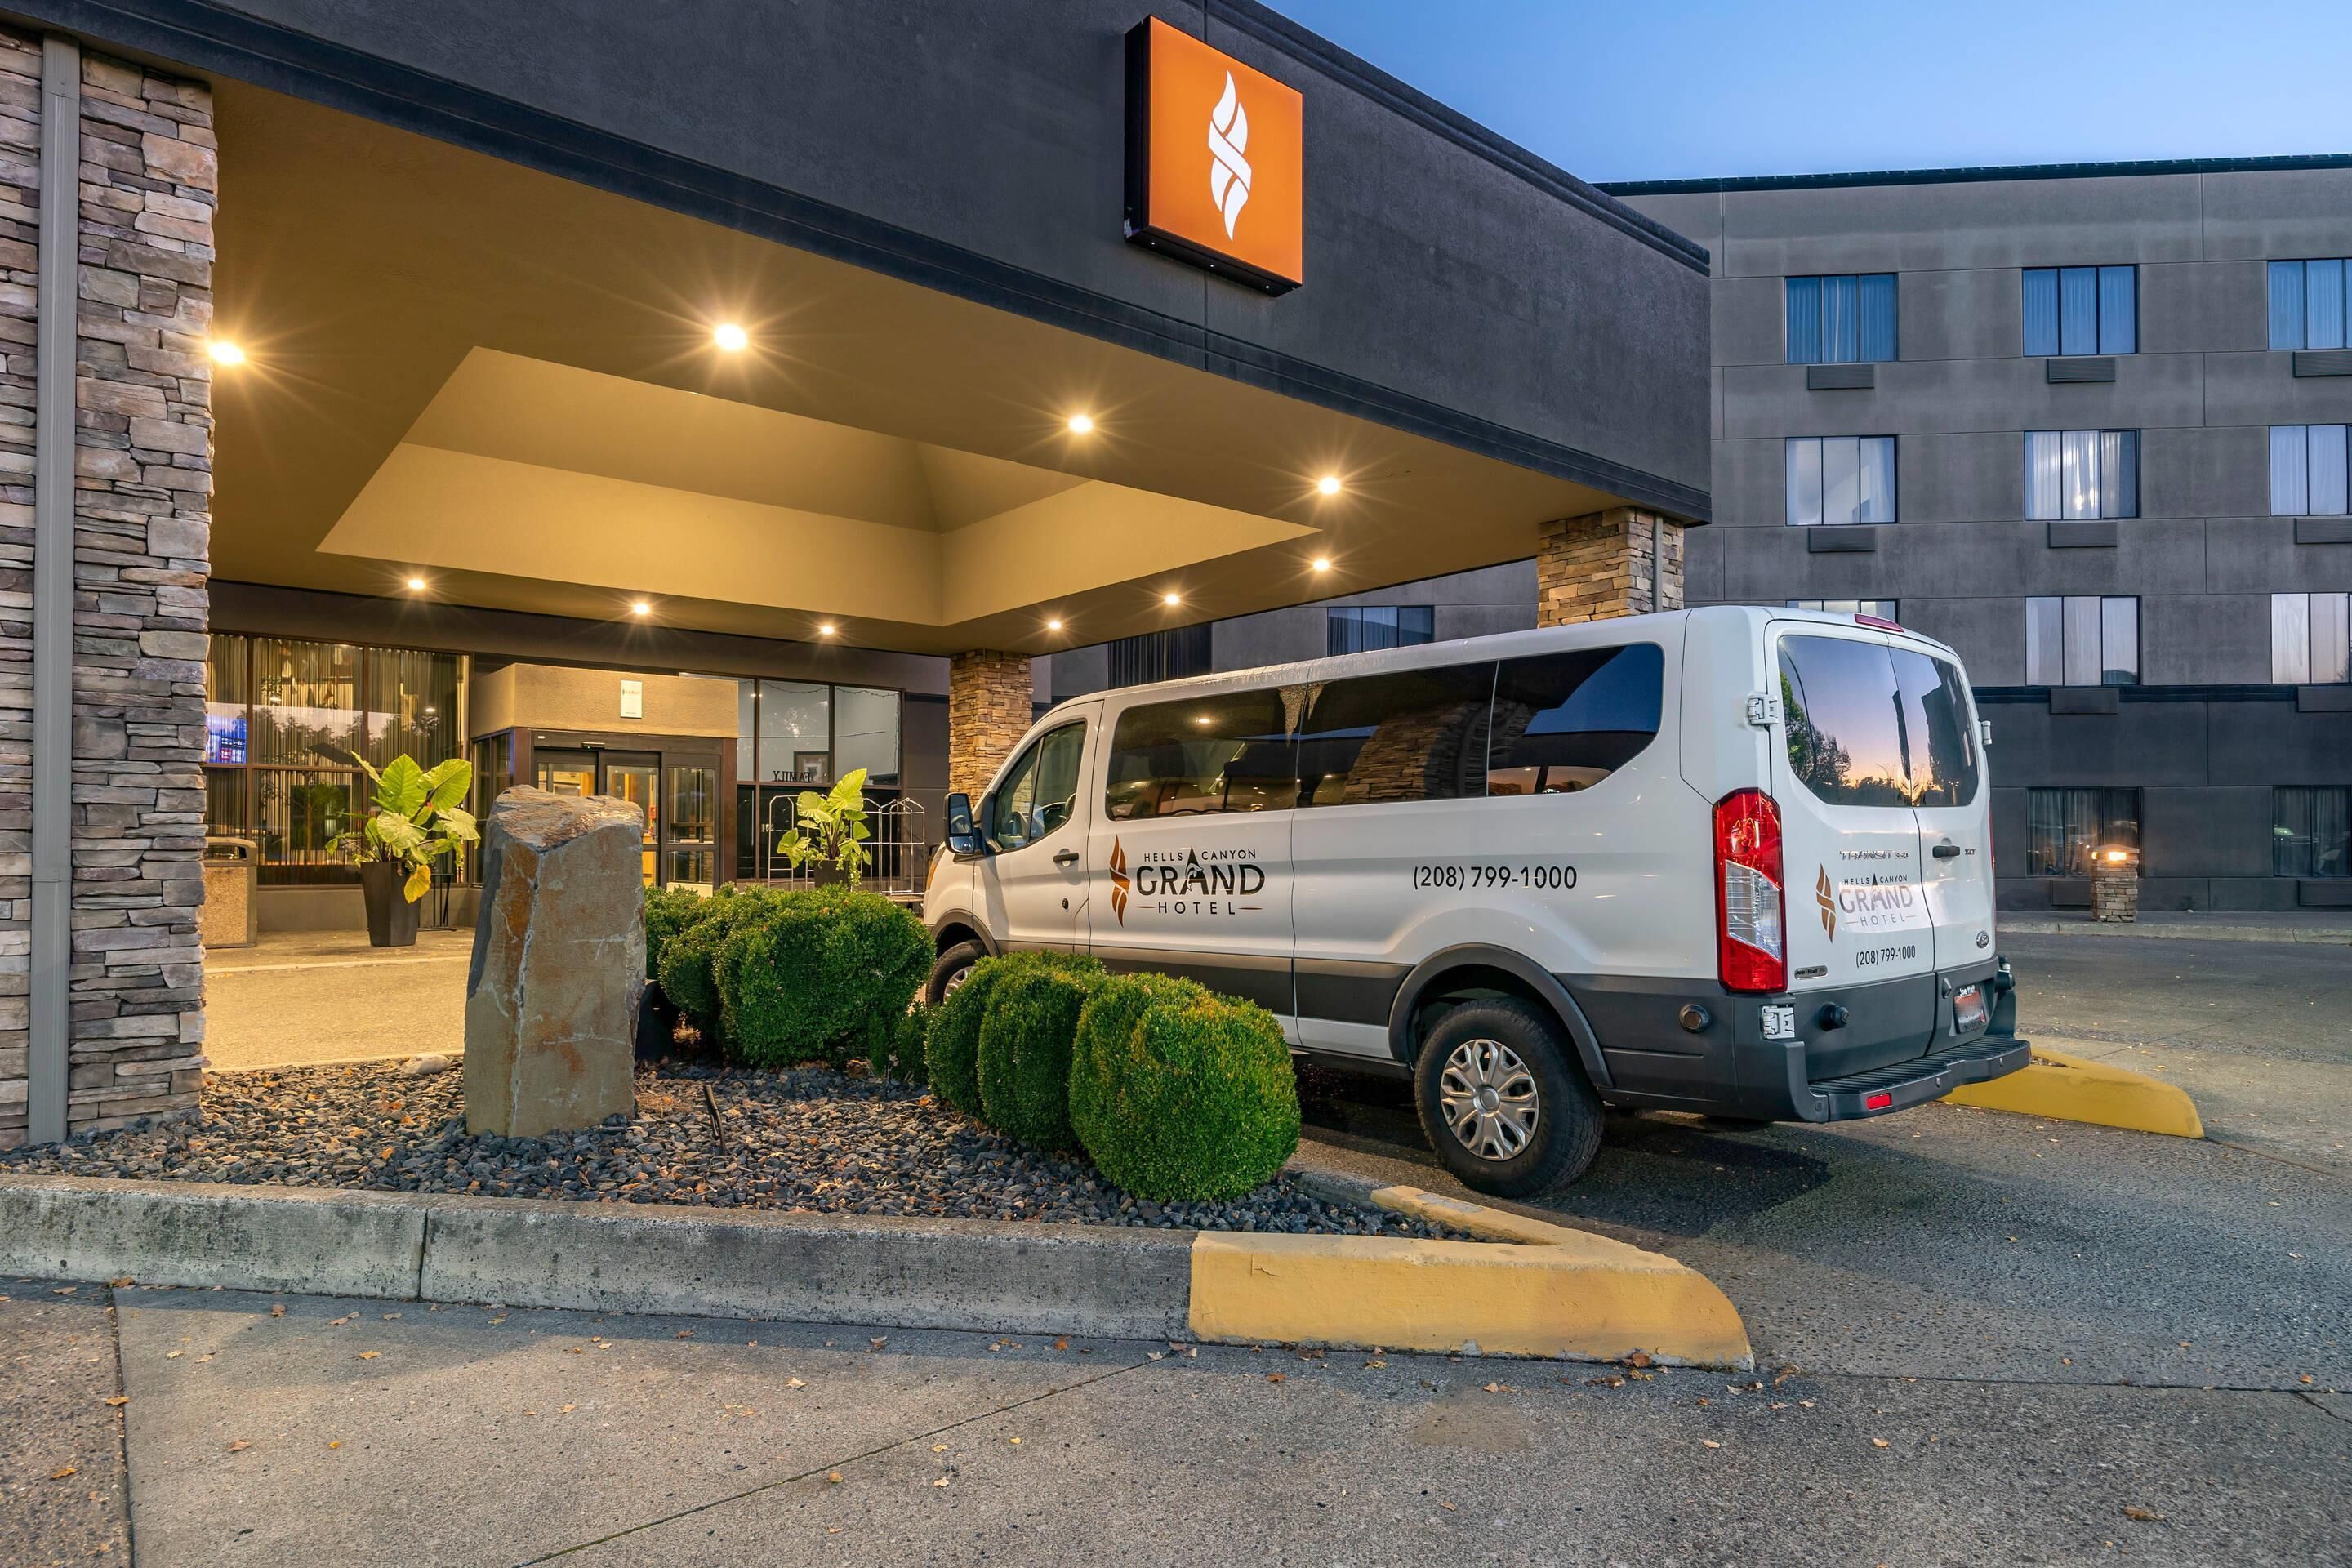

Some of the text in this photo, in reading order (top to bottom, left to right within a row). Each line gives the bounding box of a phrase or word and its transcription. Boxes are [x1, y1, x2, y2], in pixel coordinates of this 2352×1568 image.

[1144, 849, 1256, 862] HELLS CANYON
[1840, 850, 1892, 860] TRANSIT
[1136, 846, 1265, 896] GRAND
[1414, 866, 1577, 891] (208) 799-1000
[1844, 875, 1908, 885] HELLS CANYON
[1839, 873, 1913, 914] GRAND
[1158, 901, 1236, 915] HOTEL
[1860, 912, 1905, 927] HOTEL
[1856, 945, 1916, 969] (208) 799-1000
